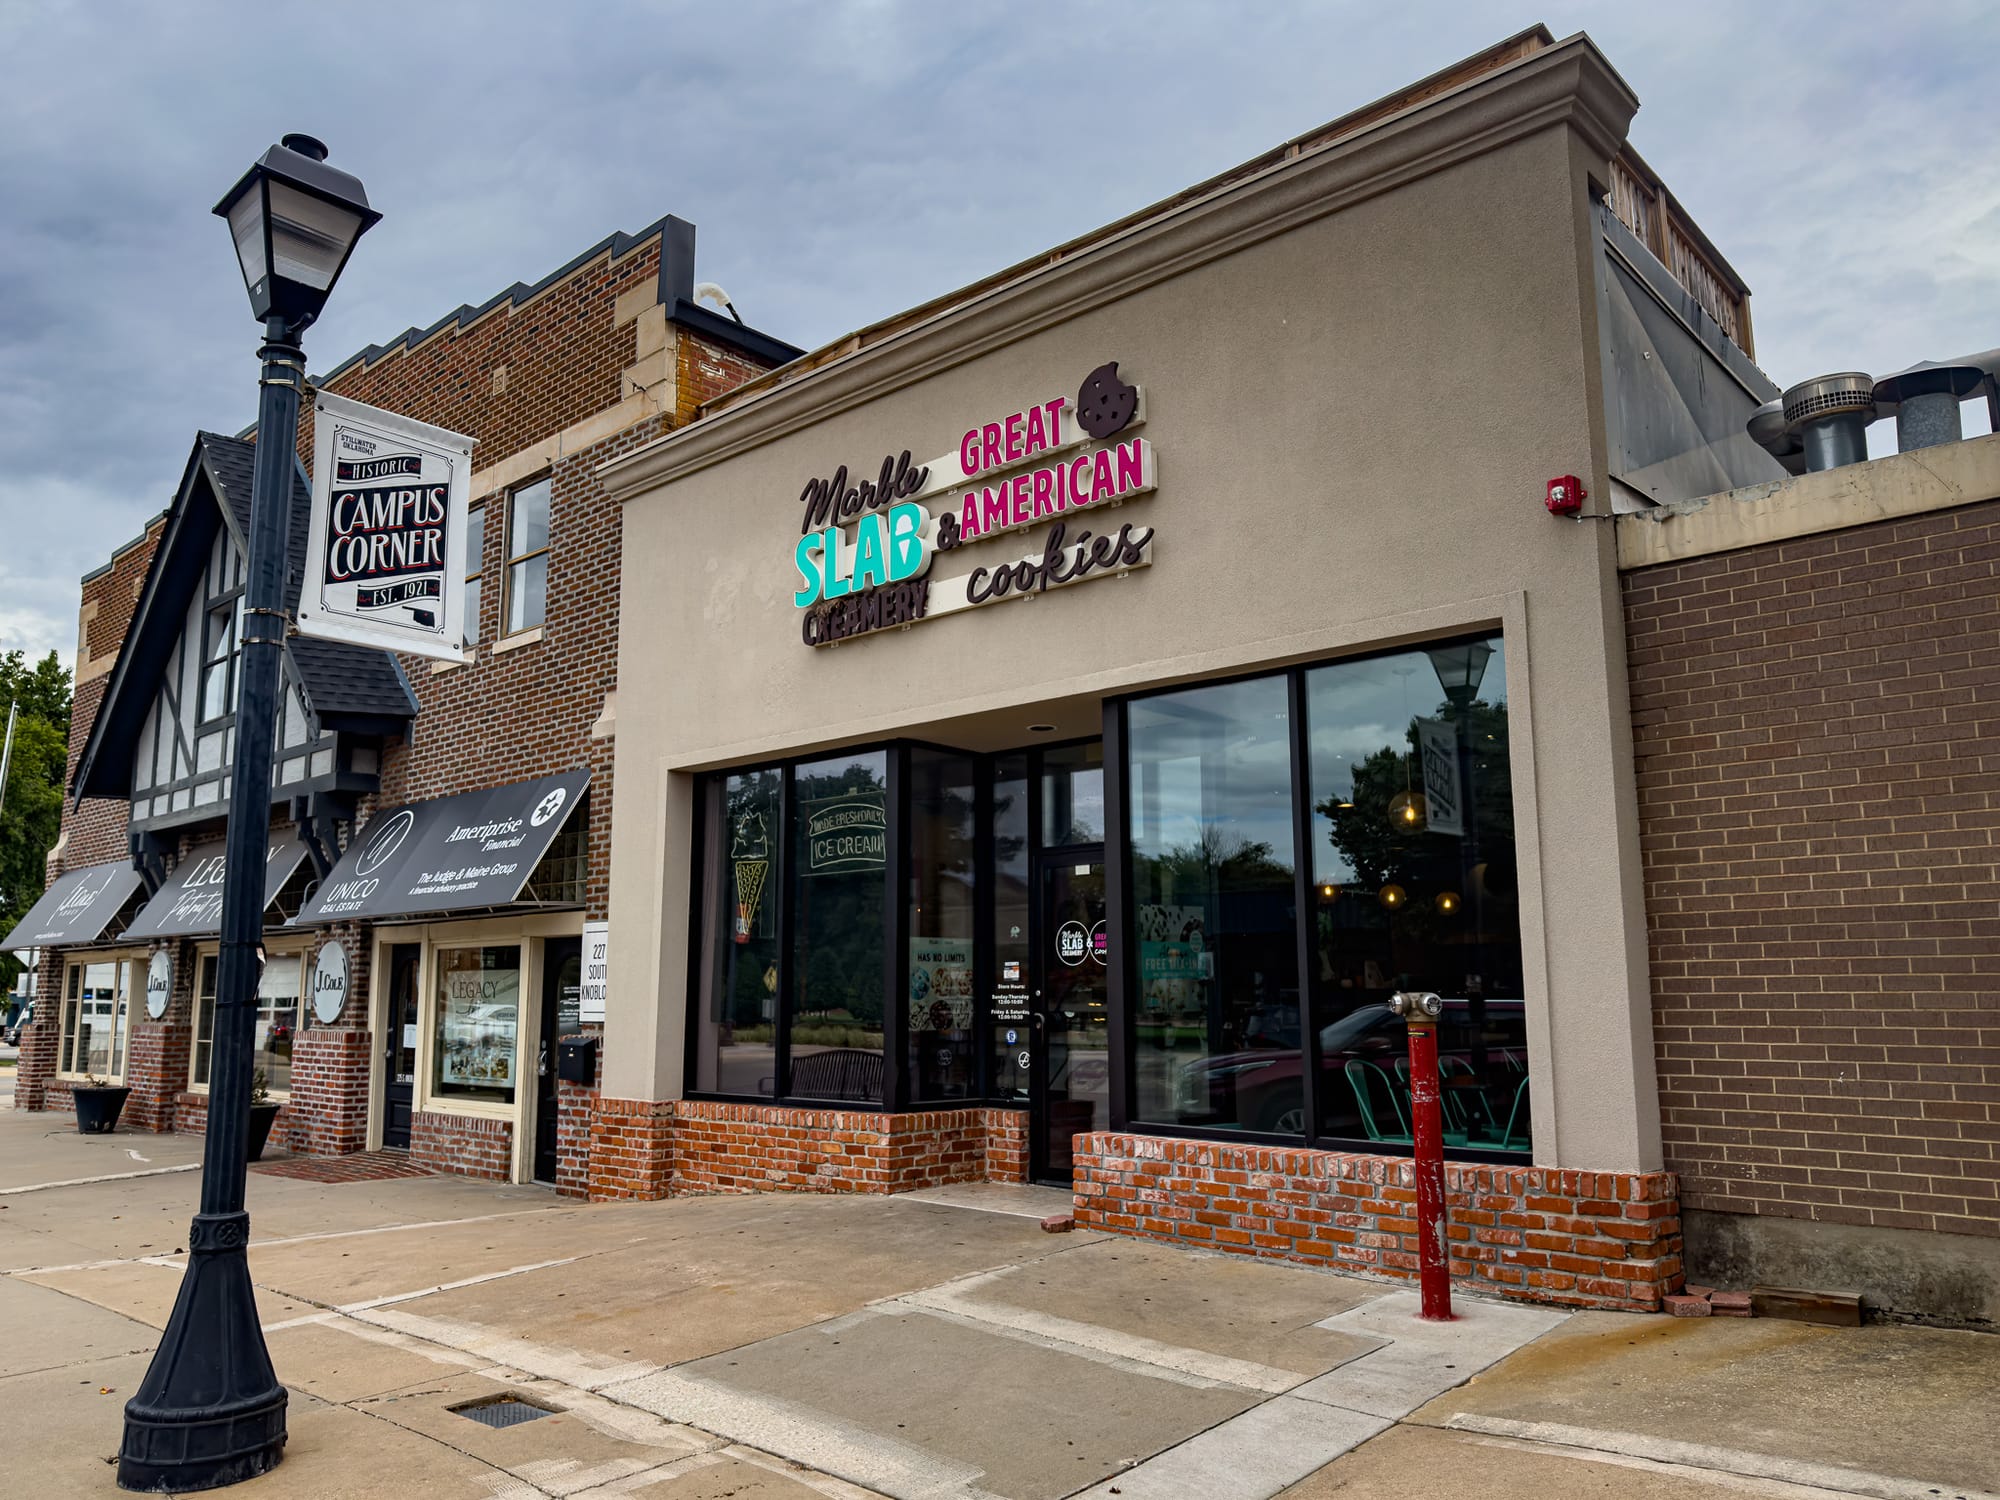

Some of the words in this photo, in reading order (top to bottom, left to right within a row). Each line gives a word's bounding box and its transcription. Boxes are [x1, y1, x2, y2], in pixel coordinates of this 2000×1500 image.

[341, 434, 377, 451] STILLWATER
[343, 442, 374, 456] OKLAHOMA
[960, 397, 1067, 476] GREAT
[352, 458, 410, 480] HISTORIC
[800, 450, 929, 535] Marble
[937, 512, 963, 551] &
[960, 438, 1145, 541] AMERICAN
[333, 486, 446, 538] CAMPUS
[330, 529, 442, 580] CORNER
[794, 502, 927, 608] SLAB
[966, 521, 1155, 604] cookies
[373, 588, 398, 606] EST.
[403, 580, 428, 599] 1921
[802, 579, 930, 646] CREAMERY
[444, 816, 524, 845] Ameriprise
[813, 815, 835, 833] MADE
[835, 810, 861, 826] FRESH
[481, 833, 527, 853] Financial
[814, 838, 834, 859] ICE
[837, 834, 884, 856] CREAM
[181, 844, 286, 888] LEGY
[416, 872, 433, 885] The
[431, 870, 457, 884] Judge
[455, 868, 466, 880] &
[463, 865, 491, 879] Maine
[489, 862, 518, 876] Group
[326, 877, 380, 903] UNICO
[317, 903, 337, 914] REAL
[335, 900, 364, 912] ESTATE
[593, 943, 607, 960] 227
[1061, 938, 1084, 950] SLAB
[917, 952, 931, 962] HAS
[932, 952, 942, 962] NO
[944, 952, 966, 963] LIMITS
[452, 981, 499, 999] LEGACY
